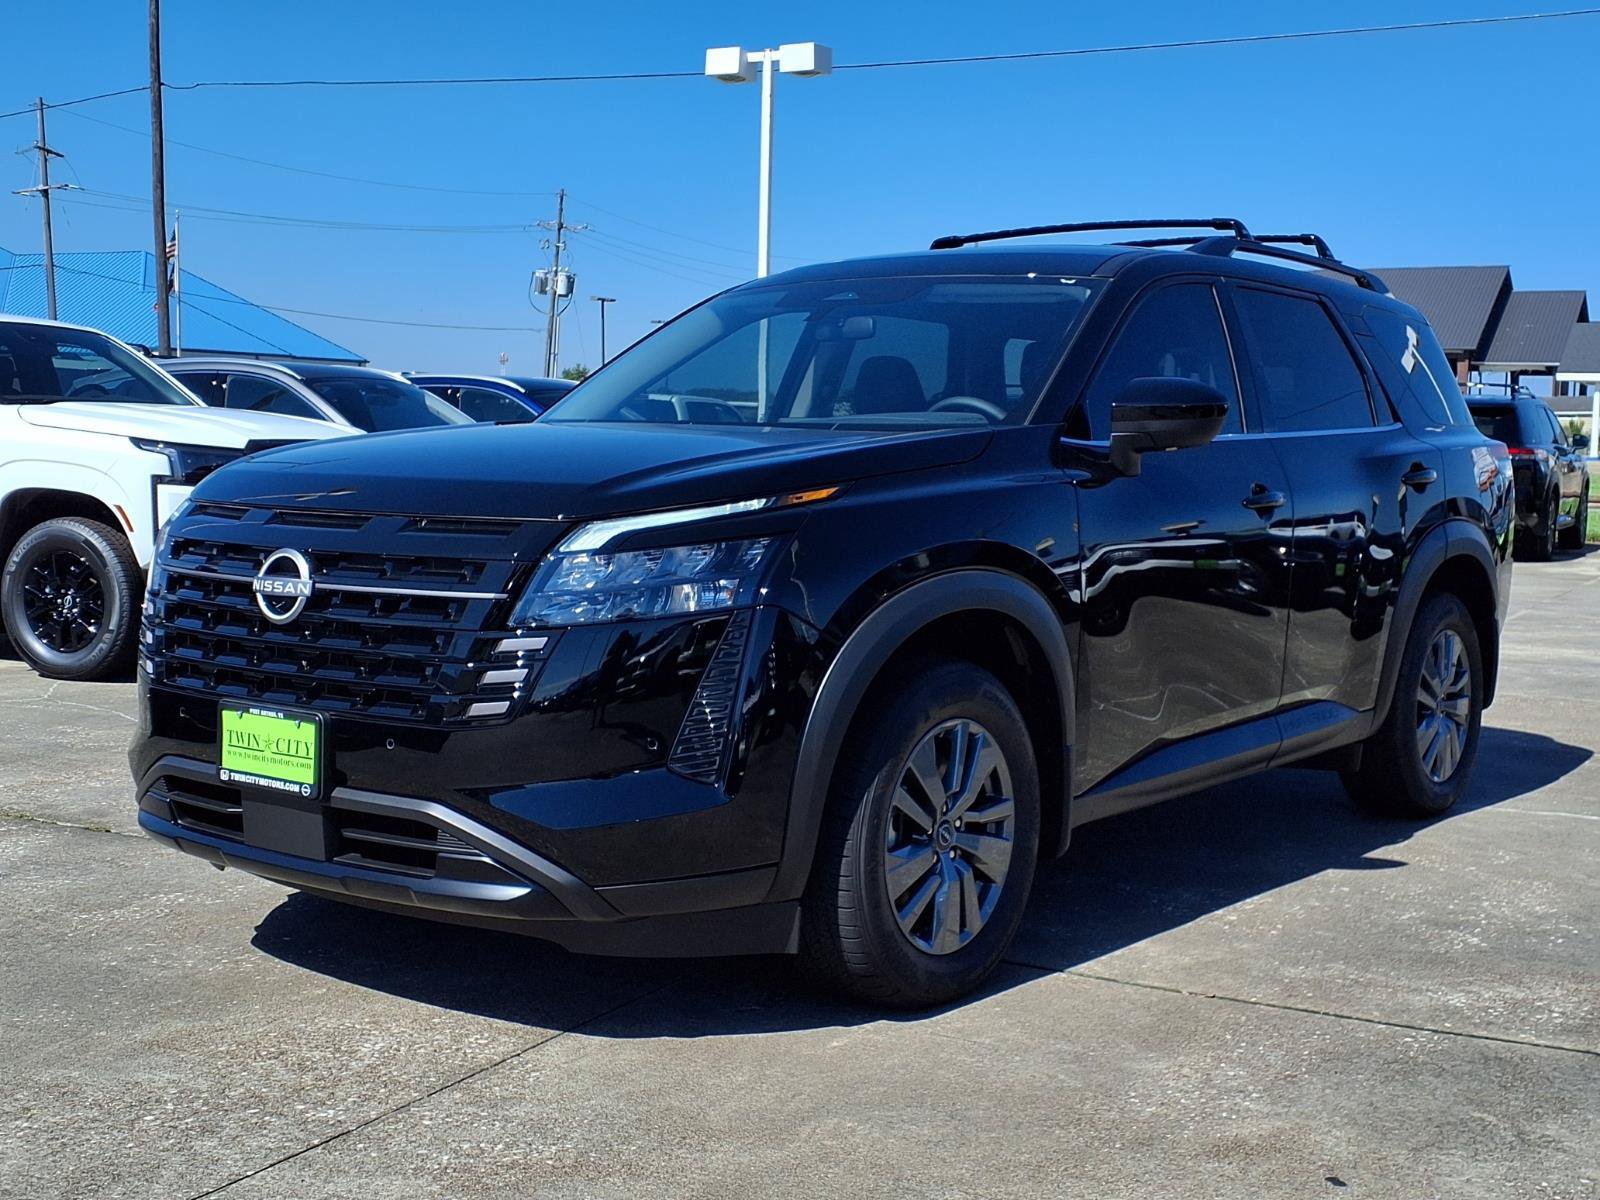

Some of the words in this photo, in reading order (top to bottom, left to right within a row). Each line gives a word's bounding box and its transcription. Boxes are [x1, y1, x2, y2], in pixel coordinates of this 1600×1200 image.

[252, 579, 310, 595] NISSAN
[227, 729, 261, 749] TWIN
[275, 737, 313, 757] CITY
